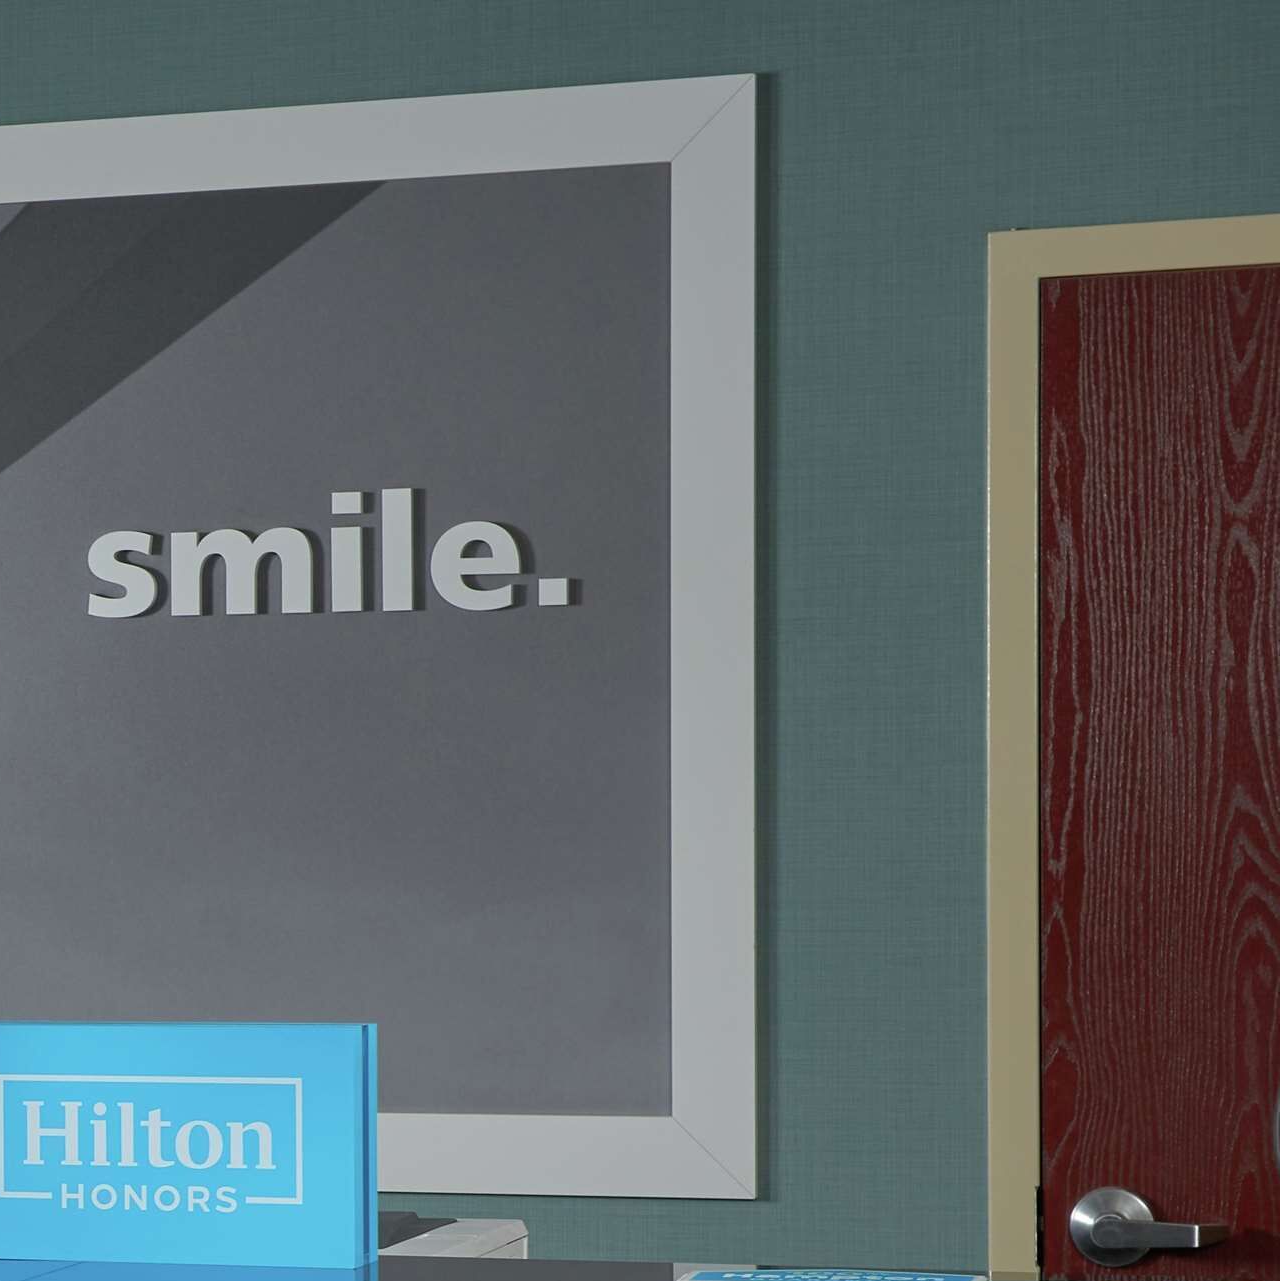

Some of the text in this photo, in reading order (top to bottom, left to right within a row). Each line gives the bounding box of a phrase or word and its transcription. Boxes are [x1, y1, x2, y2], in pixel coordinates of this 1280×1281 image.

[87, 488, 569, 619] smile.
[22, 1101, 277, 1170] Hilton
[60, 1183, 238, 1213] HONORS
[721, 1272, 945, 1281] Hampton
